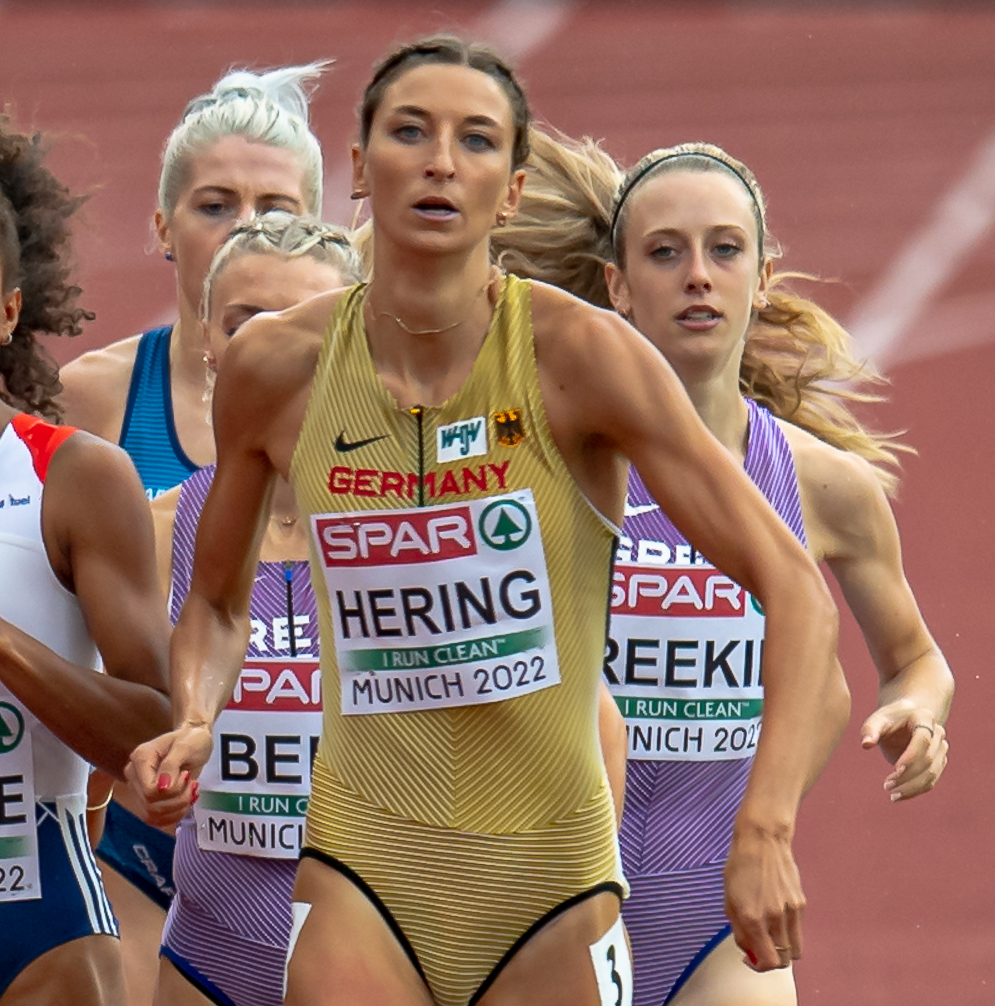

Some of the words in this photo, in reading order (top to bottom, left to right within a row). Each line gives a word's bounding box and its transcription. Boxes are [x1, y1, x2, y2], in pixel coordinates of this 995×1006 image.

[328, 460, 510, 499] GERMANY
[322, 515, 471, 560] SPAR
[336, 570, 542, 639] HERING
[393, 648, 430, 667] RUN
[352, 672, 464, 705] MUNICH
[473, 656, 546, 695] 2022
[636, 702, 677, 717] RUN
[626, 726, 703, 753] NICH
[249, 797, 289, 813] RUN
